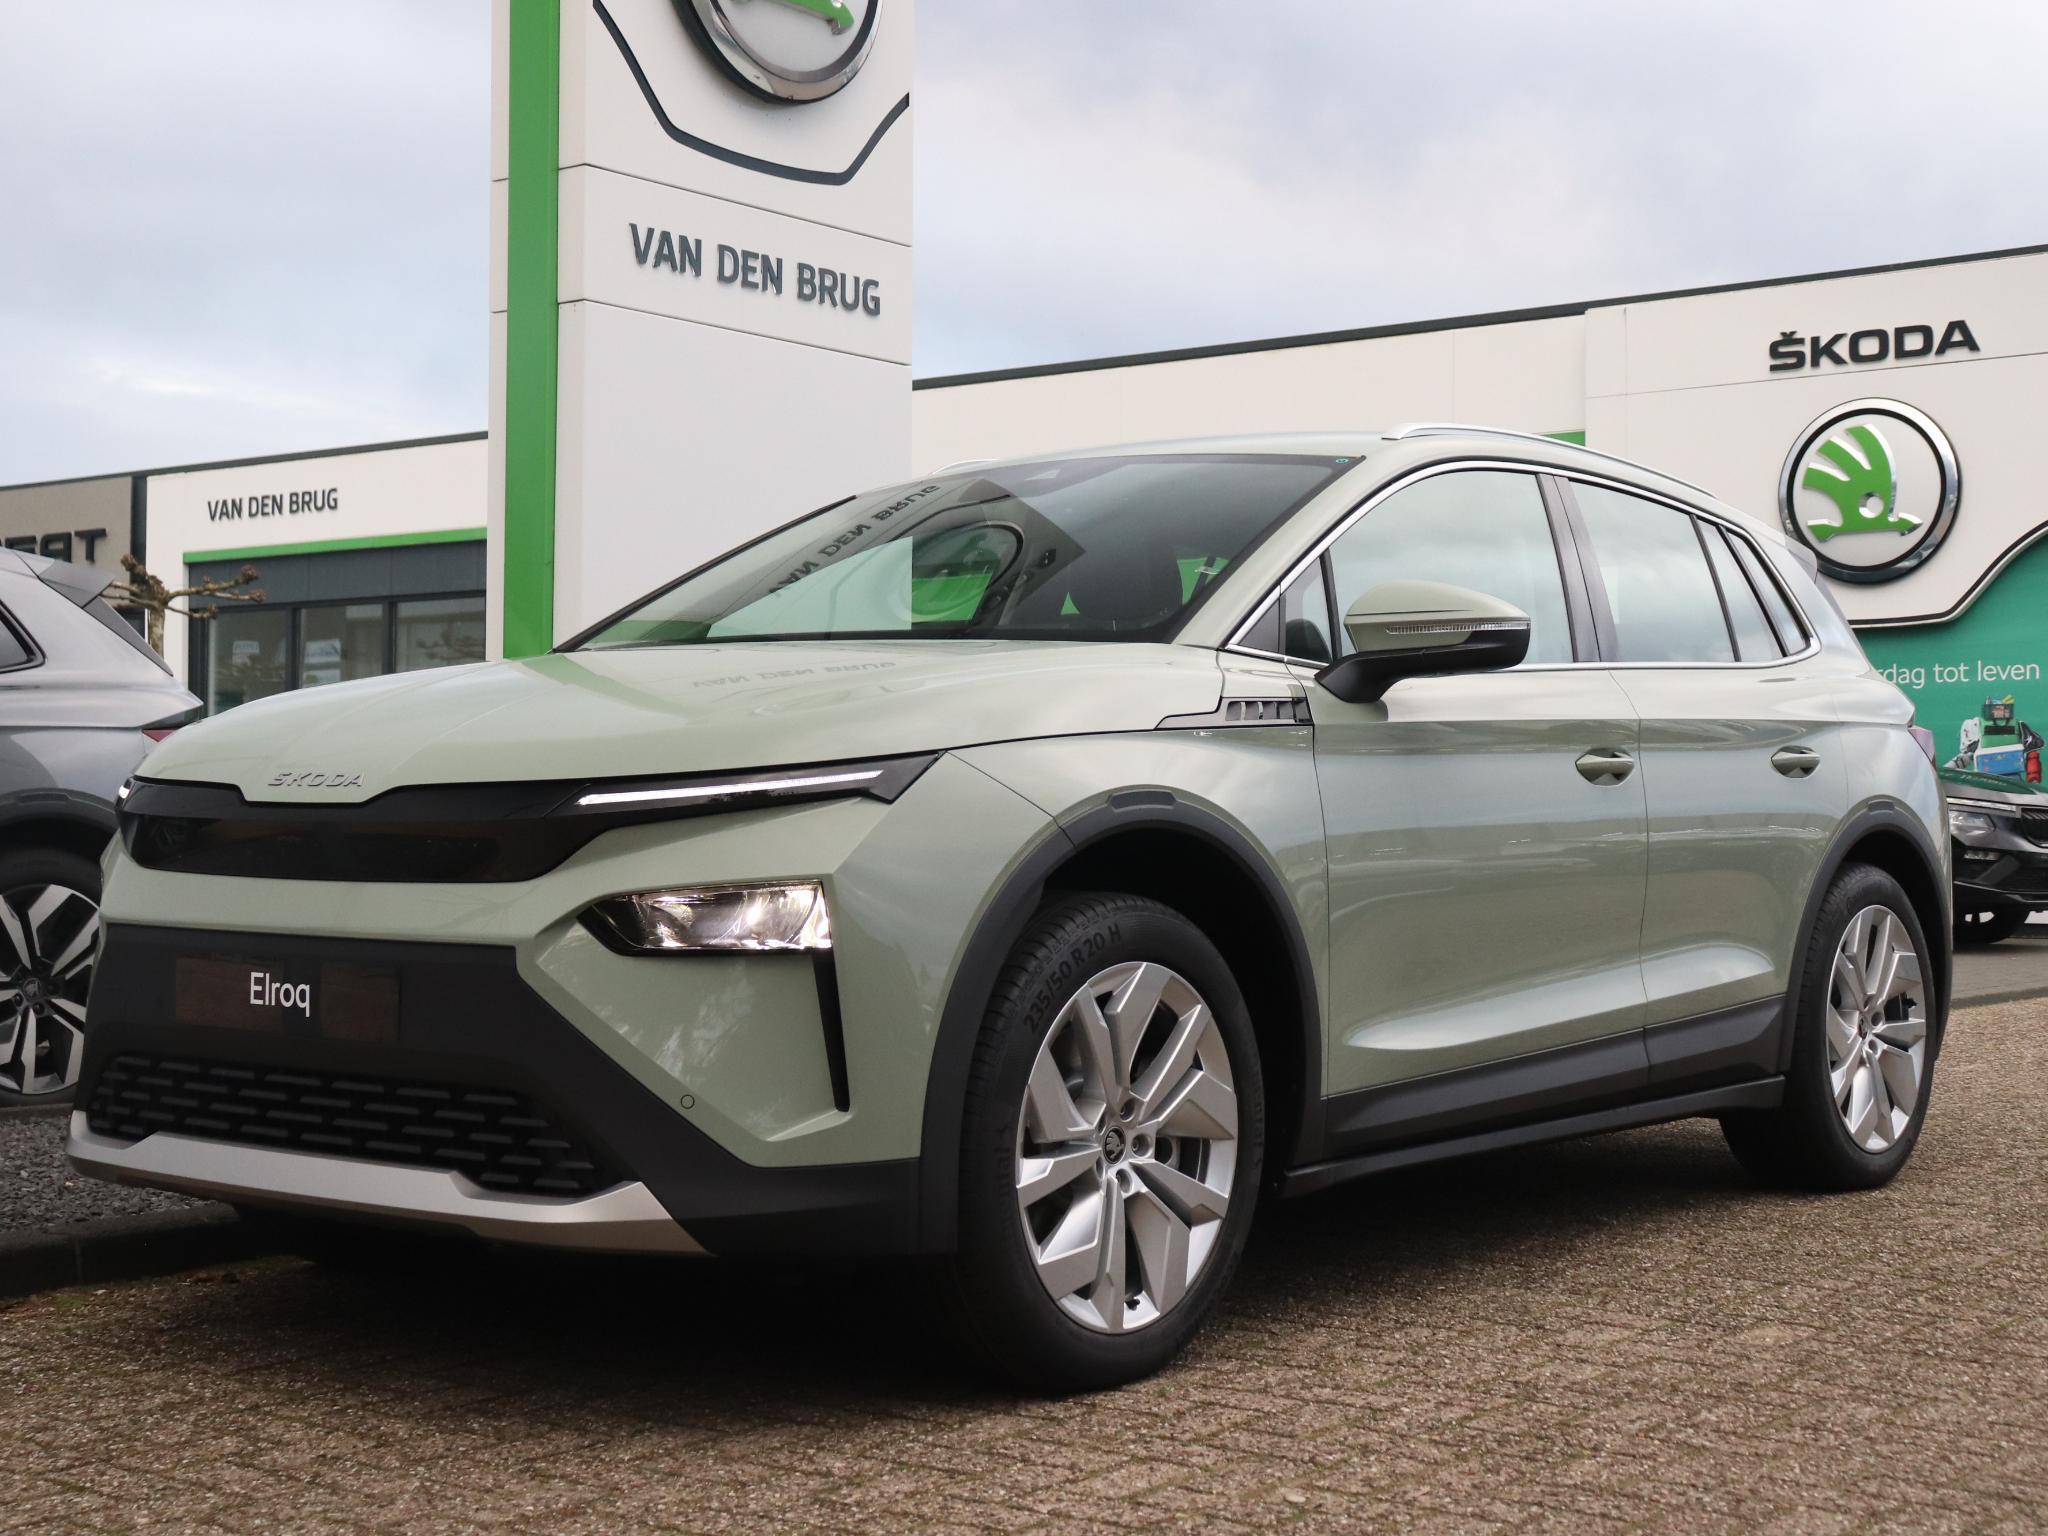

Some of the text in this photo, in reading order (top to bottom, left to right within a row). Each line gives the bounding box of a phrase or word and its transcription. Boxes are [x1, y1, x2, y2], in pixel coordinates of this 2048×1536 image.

[629, 222, 881, 316] VAN DEN BRUG
[1769, 319, 1981, 372] ŠKODA
[207, 488, 338, 521] VAN DEN BRUG
[0, 528, 107, 565] AT
[1933, 662, 1970, 683] tot
[1977, 660, 2040, 681] leven
[250, 971, 311, 1018] Elroq
[1023, 960, 1072, 1033] 235/50
